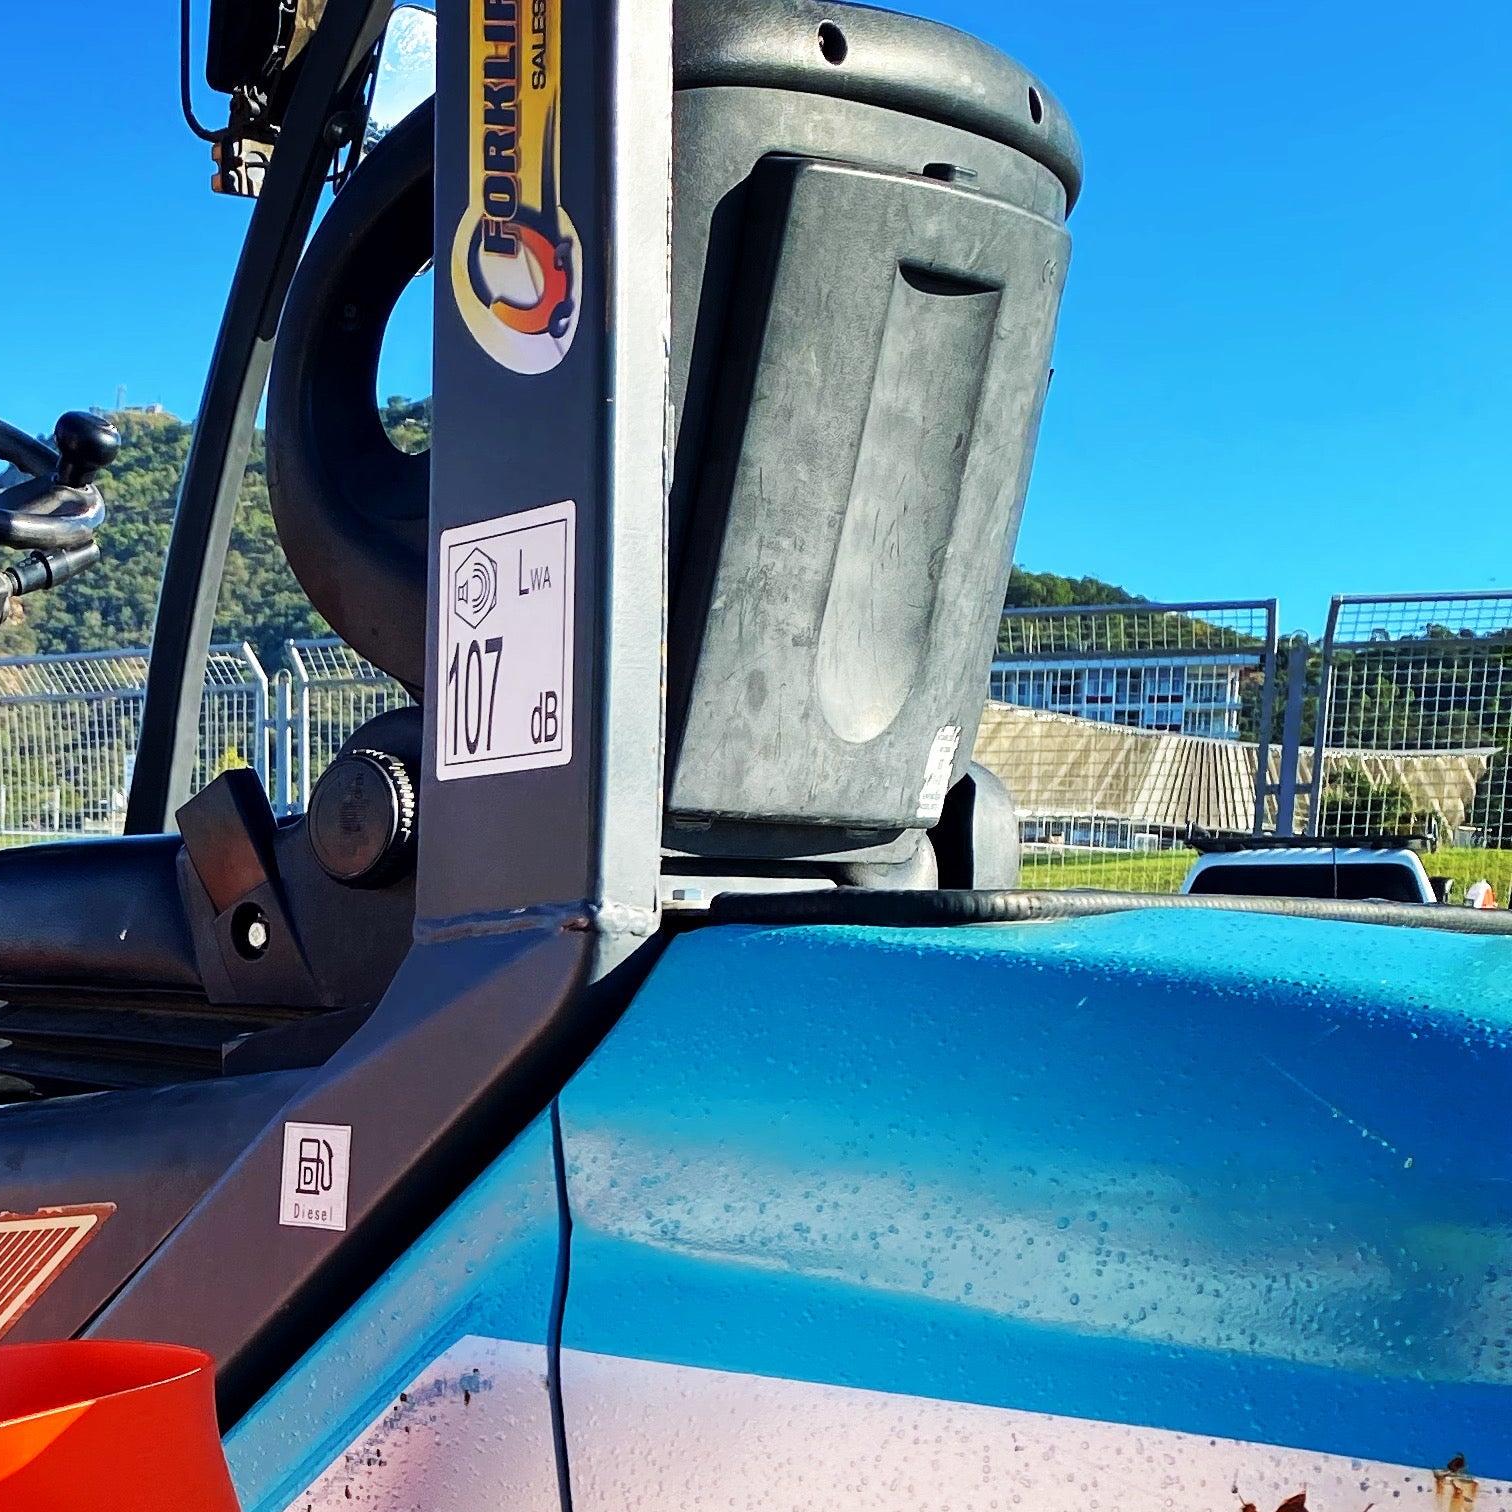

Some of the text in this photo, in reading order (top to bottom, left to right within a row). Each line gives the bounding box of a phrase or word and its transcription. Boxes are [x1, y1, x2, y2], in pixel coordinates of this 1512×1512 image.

[531, 0, 547, 90] SALES
[448, 637, 503, 755] 107
[530, 691, 558, 744] dB
[293, 1203, 333, 1222] Diesel
